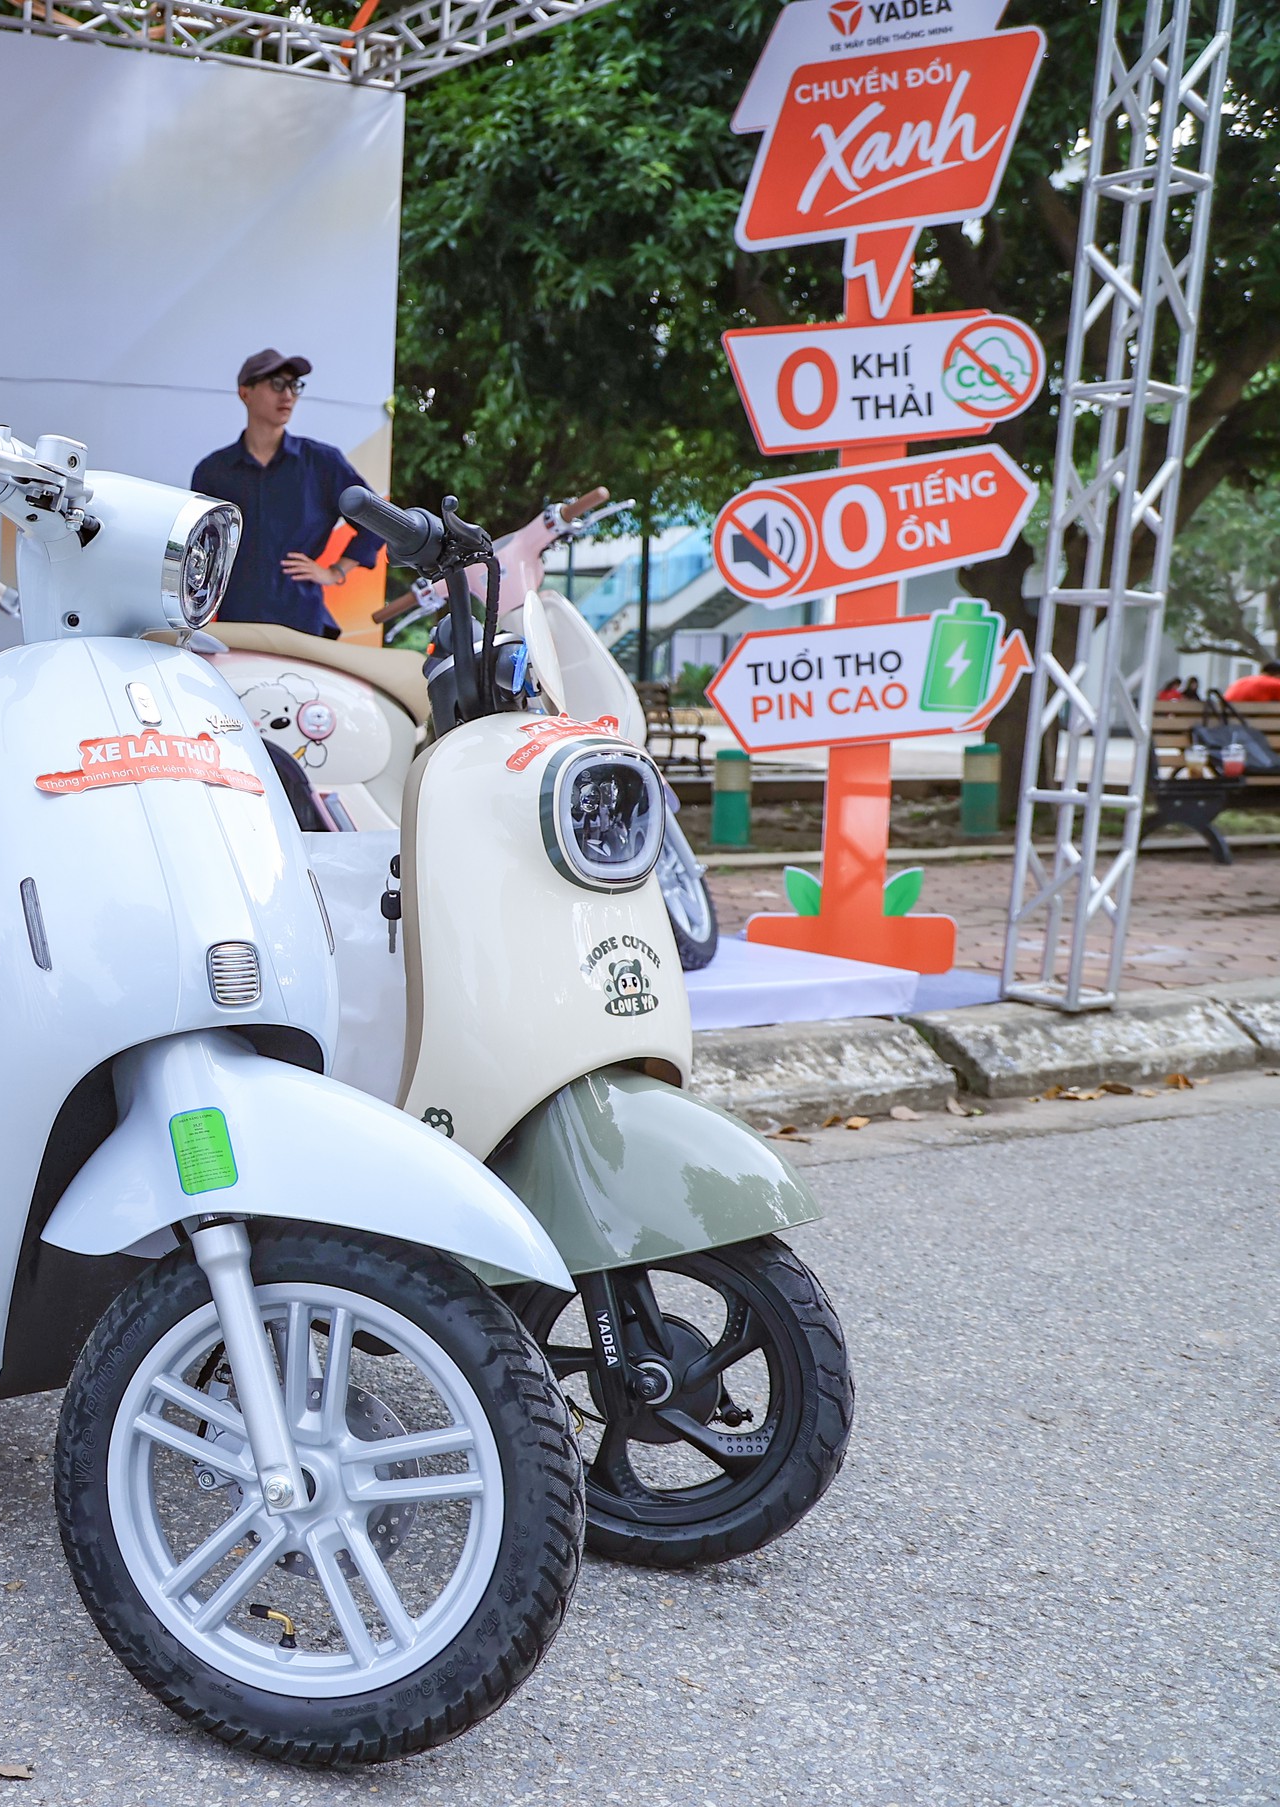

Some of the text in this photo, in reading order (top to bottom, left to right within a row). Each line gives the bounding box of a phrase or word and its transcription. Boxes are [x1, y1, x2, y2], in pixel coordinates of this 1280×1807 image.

[868, 0, 952, 23] YADEA
[793, 57, 953, 104] CHUYỂN ĐỔI
[796, 69, 1006, 215] Xanh
[850, 345, 913, 380] KHÍ
[776, 346, 838, 431] 0
[851, 386, 933, 421] THẢI
[889, 468, 998, 510] TIẾNG
[821, 483, 887, 571] 0
[896, 508, 951, 551] ỒN
[747, 648, 902, 686] TUỔI THỌ
[751, 682, 908, 724] PIN CAO
[531, 721, 557, 735] XE
[86, 735, 215, 765] XE LÁI THỬ
[513, 744, 540, 766] Thông
[43, 777, 80, 790] Thông
[81, 771, 111, 783] minh
[112, 768, 134, 778] hơn
[140, 764, 161, 774] Tiết
[162, 764, 187, 775] kiệm
[580, 935, 661, 976] MORE CUTER
[610, 995, 655, 1015] LOVE YA
[597, 1312, 618, 1366] YADEA
[75, 1316, 145, 1484] Vee Rubber
